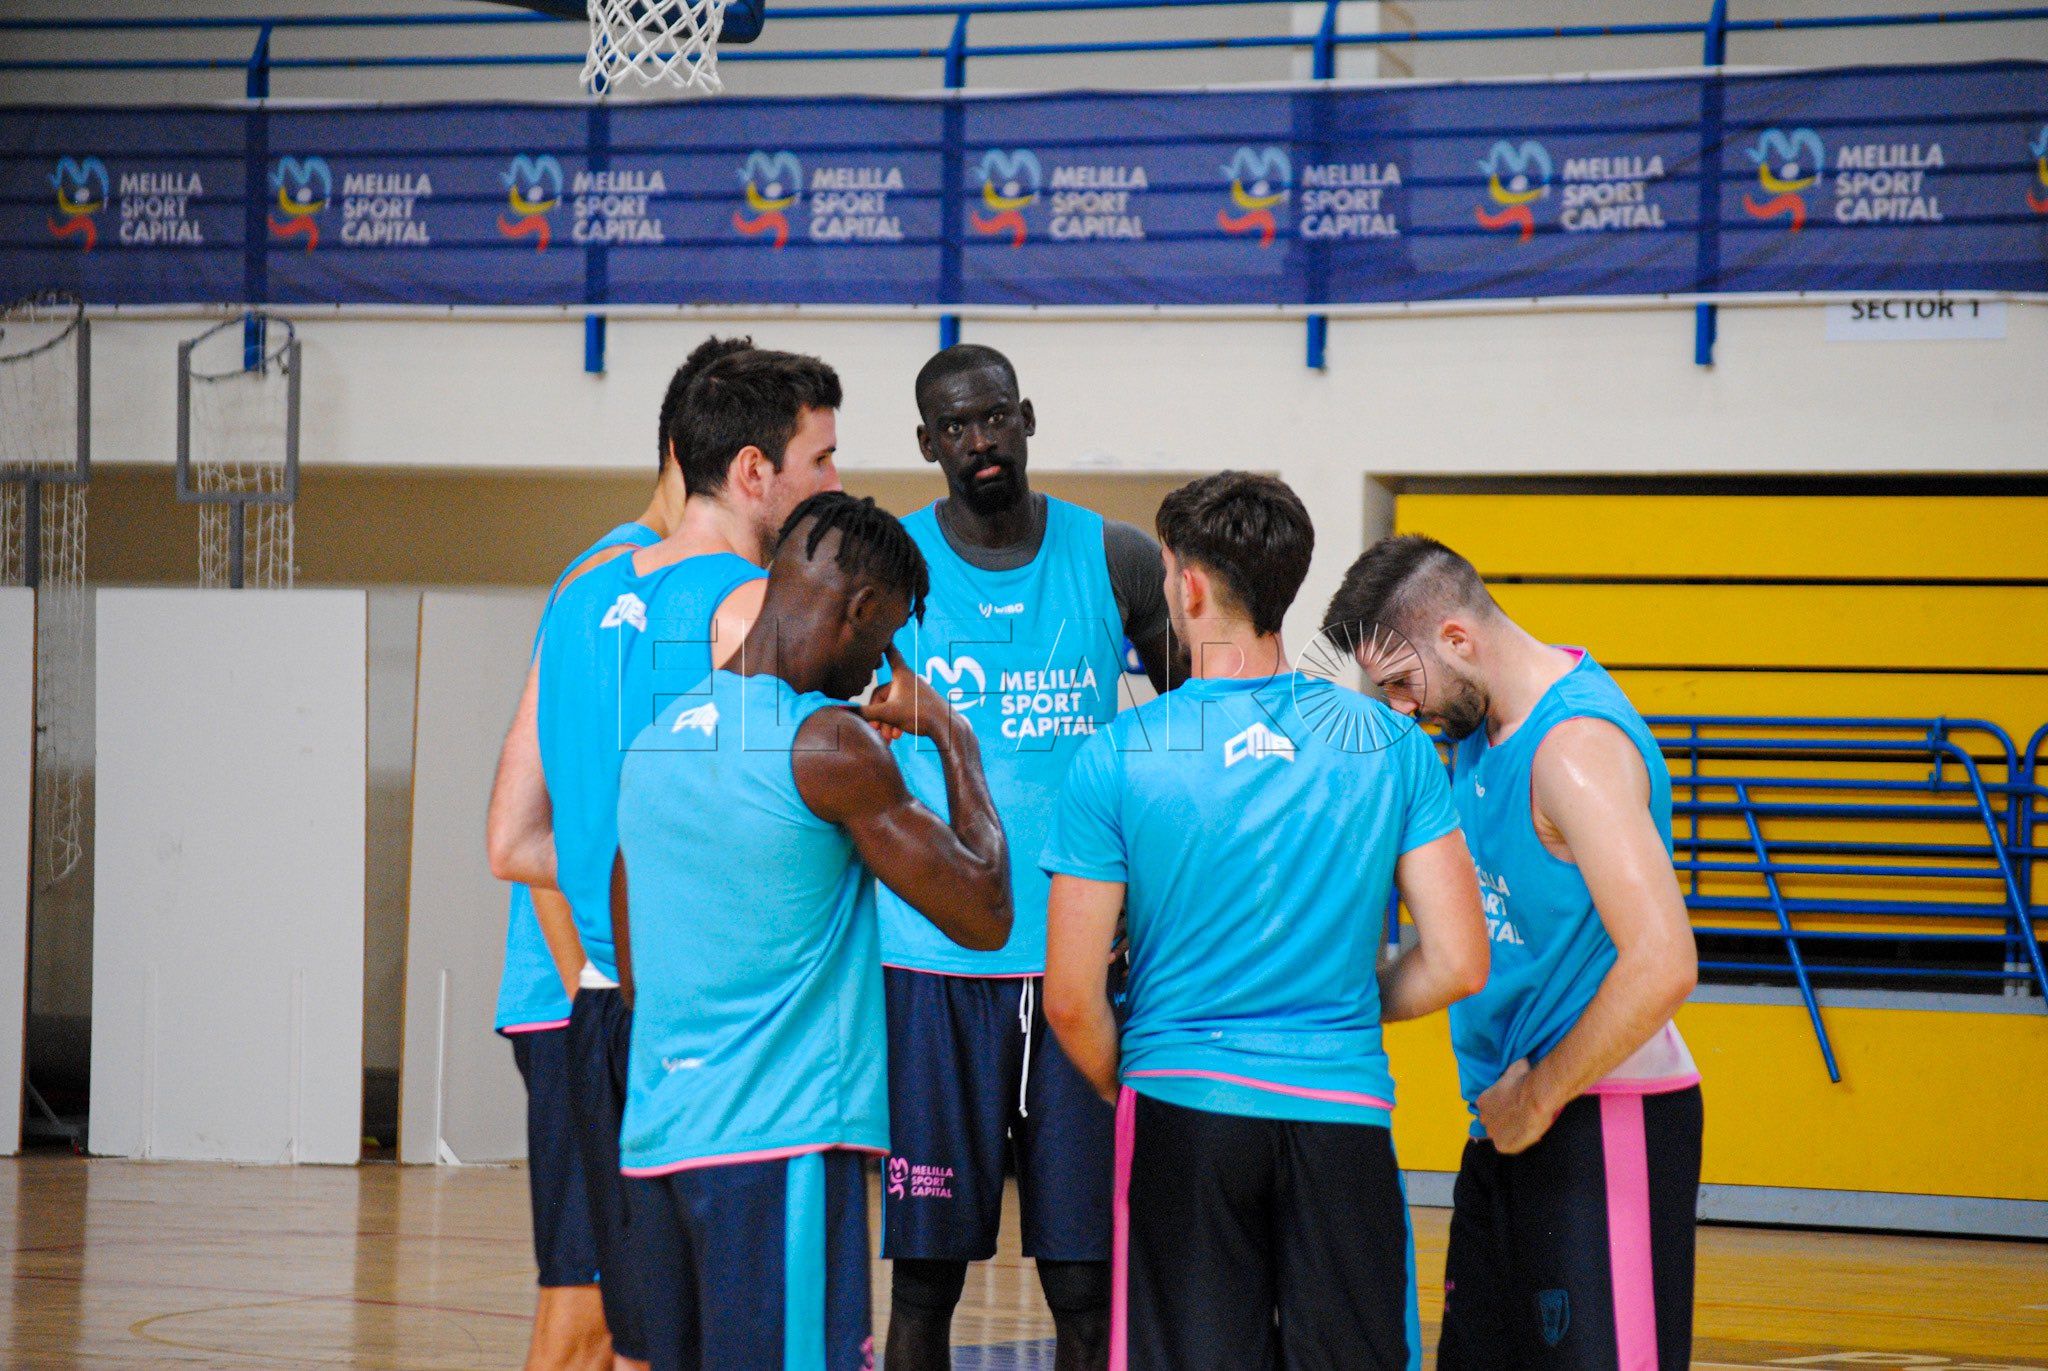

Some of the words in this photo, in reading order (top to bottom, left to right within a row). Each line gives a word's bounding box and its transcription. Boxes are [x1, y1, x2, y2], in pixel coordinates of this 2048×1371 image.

[1563, 154, 1665, 180] MELILLA
[1836, 143, 1945, 169] MELILLA
[120, 172, 203, 195] MELILLA
[342, 172, 433, 195] MELILLA
[572, 170, 666, 193] MELILLA
[811, 167, 904, 190] MELILLA
[1050, 165, 1148, 189] MELILLA
[1301, 162, 1401, 186] MELILLA
[1836, 171, 1924, 197] SPORT
[571, 194, 649, 217] SPORT
[810, 191, 887, 214] SPORT
[1049, 190, 1130, 214] SPORT
[1301, 188, 1384, 212] SPORT
[1562, 182, 1647, 206] SPORT
[120, 196, 187, 218] SPORT
[341, 196, 414, 219] SPORT
[1561, 204, 1665, 232] CAPITAL
[1835, 198, 1944, 223] CAPITAL
[119, 219, 203, 243] CAPITAL
[341, 219, 431, 244] CAPITAL
[571, 217, 665, 242] CAPITAL
[809, 215, 903, 239] CAPITAL
[1048, 214, 1145, 239] CAPITAL
[1300, 213, 1399, 238] CAPITAL
[1852, 299, 1954, 320] SECTOR
[999, 667, 1097, 692] MELILLA
[1001, 692, 1082, 715] SPORT
[1001, 714, 1098, 739] CAPITAL
[911, 1165, 953, 1177] MELILLA
[911, 1175, 946, 1187] SPORT
[911, 1187, 953, 1198] CAPITAL
